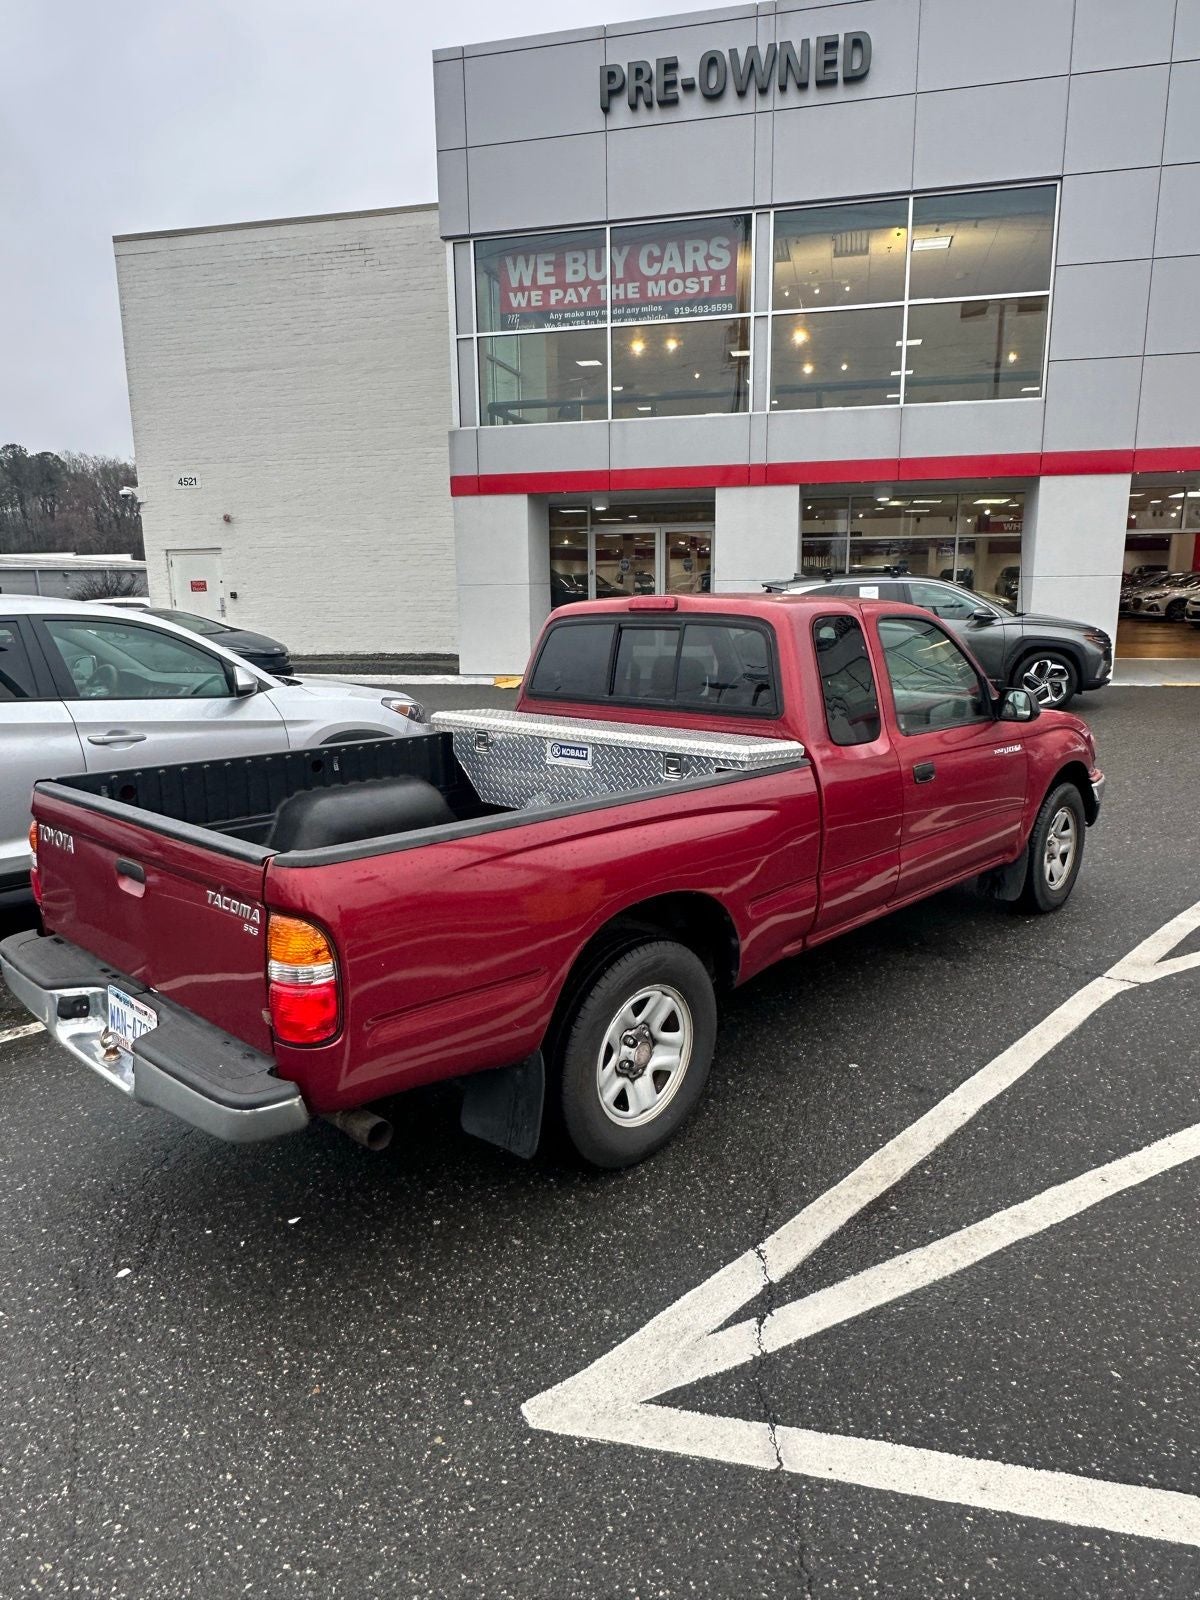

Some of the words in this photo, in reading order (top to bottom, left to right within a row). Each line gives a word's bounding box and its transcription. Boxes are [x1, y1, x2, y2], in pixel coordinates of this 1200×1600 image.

[600, 31, 872, 113] PRE-OWNED
[505, 253, 556, 288] WE
[565, 246, 631, 284] BUY
[638, 236, 732, 277] CARS
[509, 290, 543, 308] WE
[550, 286, 592, 305] PAY
[598, 282, 640, 301] THE
[648, 275, 713, 298] MOST
[549, 312, 563, 320] Any
[601, 307, 625, 315] mdel
[641, 304, 663, 313] miles
[674, 303, 733, 315] 919-493-5599
[177, 477, 197, 486] 4521
[562, 748, 587, 757] KOBALT
[39, 823, 75, 854] TOYOTA
[206, 890, 260, 924] TACOMA
